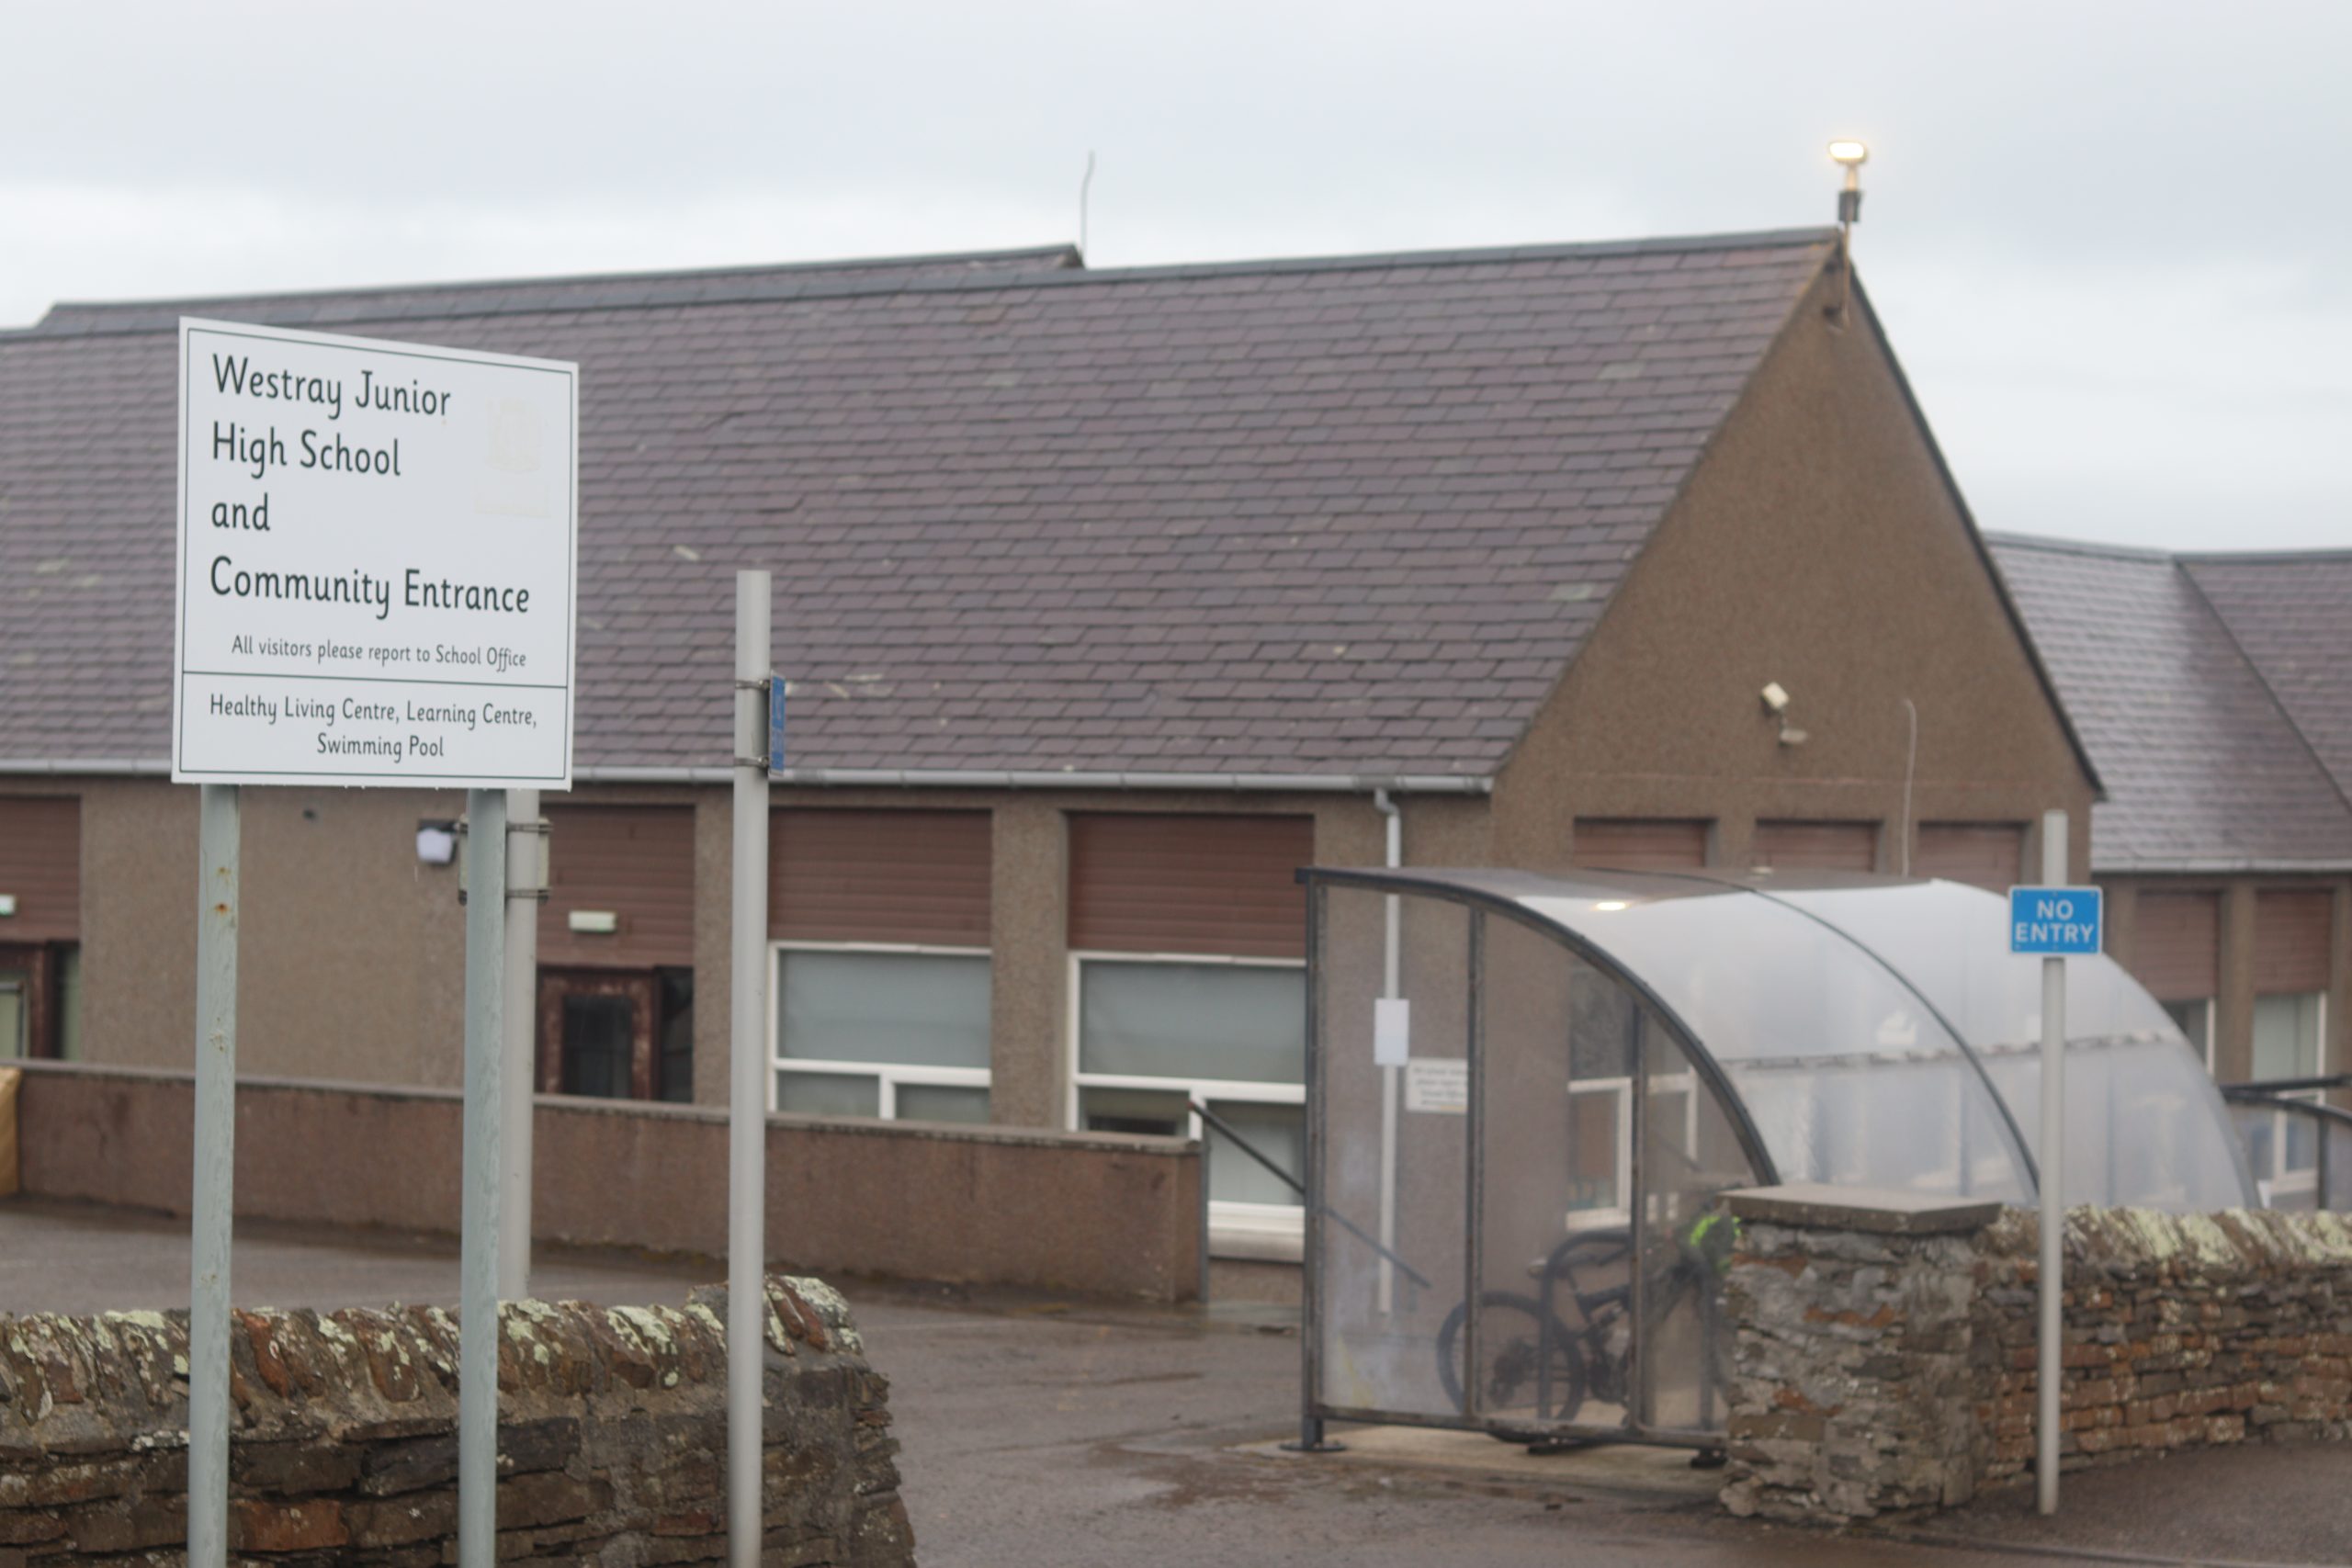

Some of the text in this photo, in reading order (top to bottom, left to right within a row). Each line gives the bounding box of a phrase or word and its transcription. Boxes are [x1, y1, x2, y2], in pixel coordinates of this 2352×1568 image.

[211, 352, 451, 422] Westray Junior
[212, 420, 401, 480] High School
[210, 491, 271, 532] and
[209, 554, 530, 621] Community Entrance
[231, 634, 526, 673] All visitors please report to School Office
[209, 693, 537, 731] Healthy Living Centre, Learning Centre,
[316, 731, 445, 764] Swimming Pool
[2037, 899, 2074, 920] NO
[2015, 921, 2095, 943] ENTRY
